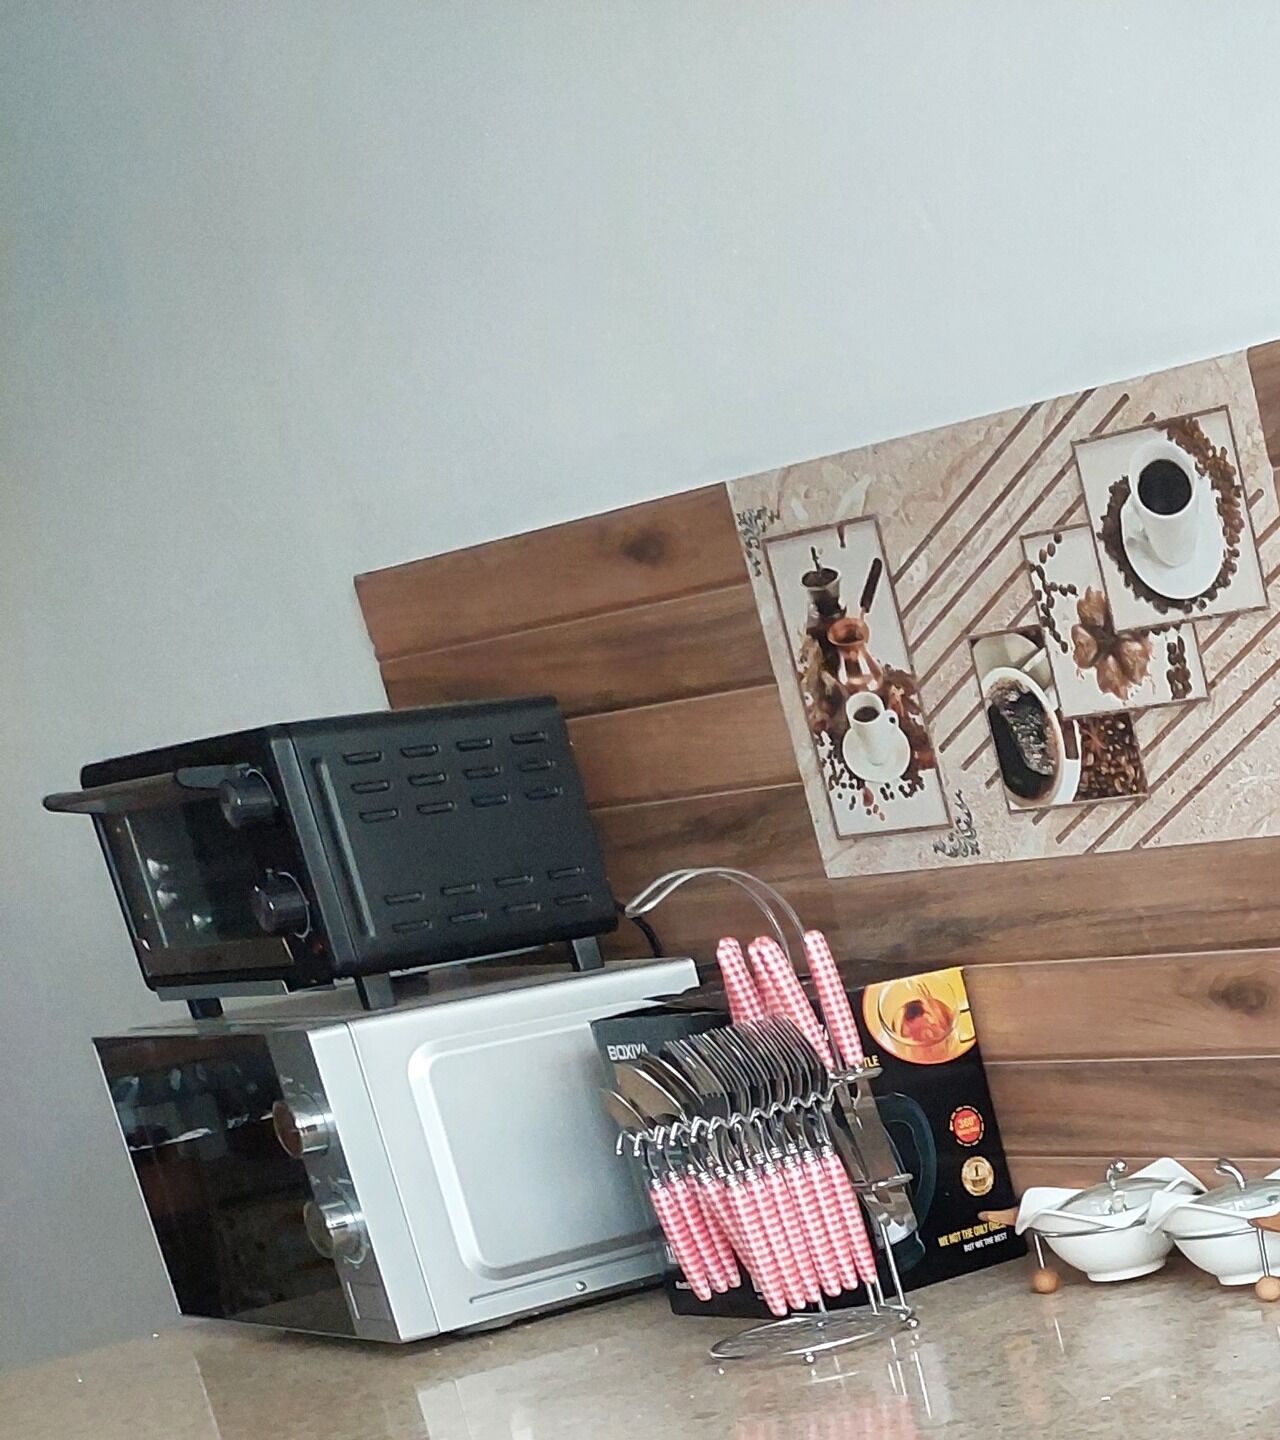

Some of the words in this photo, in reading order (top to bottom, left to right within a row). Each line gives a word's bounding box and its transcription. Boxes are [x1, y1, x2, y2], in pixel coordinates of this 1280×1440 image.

[863, 1054, 881, 1068] TLE
[961, 1227, 974, 1240] THE
[973, 1223, 988, 1237] ONLY
[984, 1236, 994, 1246] THE
[994, 1232, 1007, 1243] BEST
